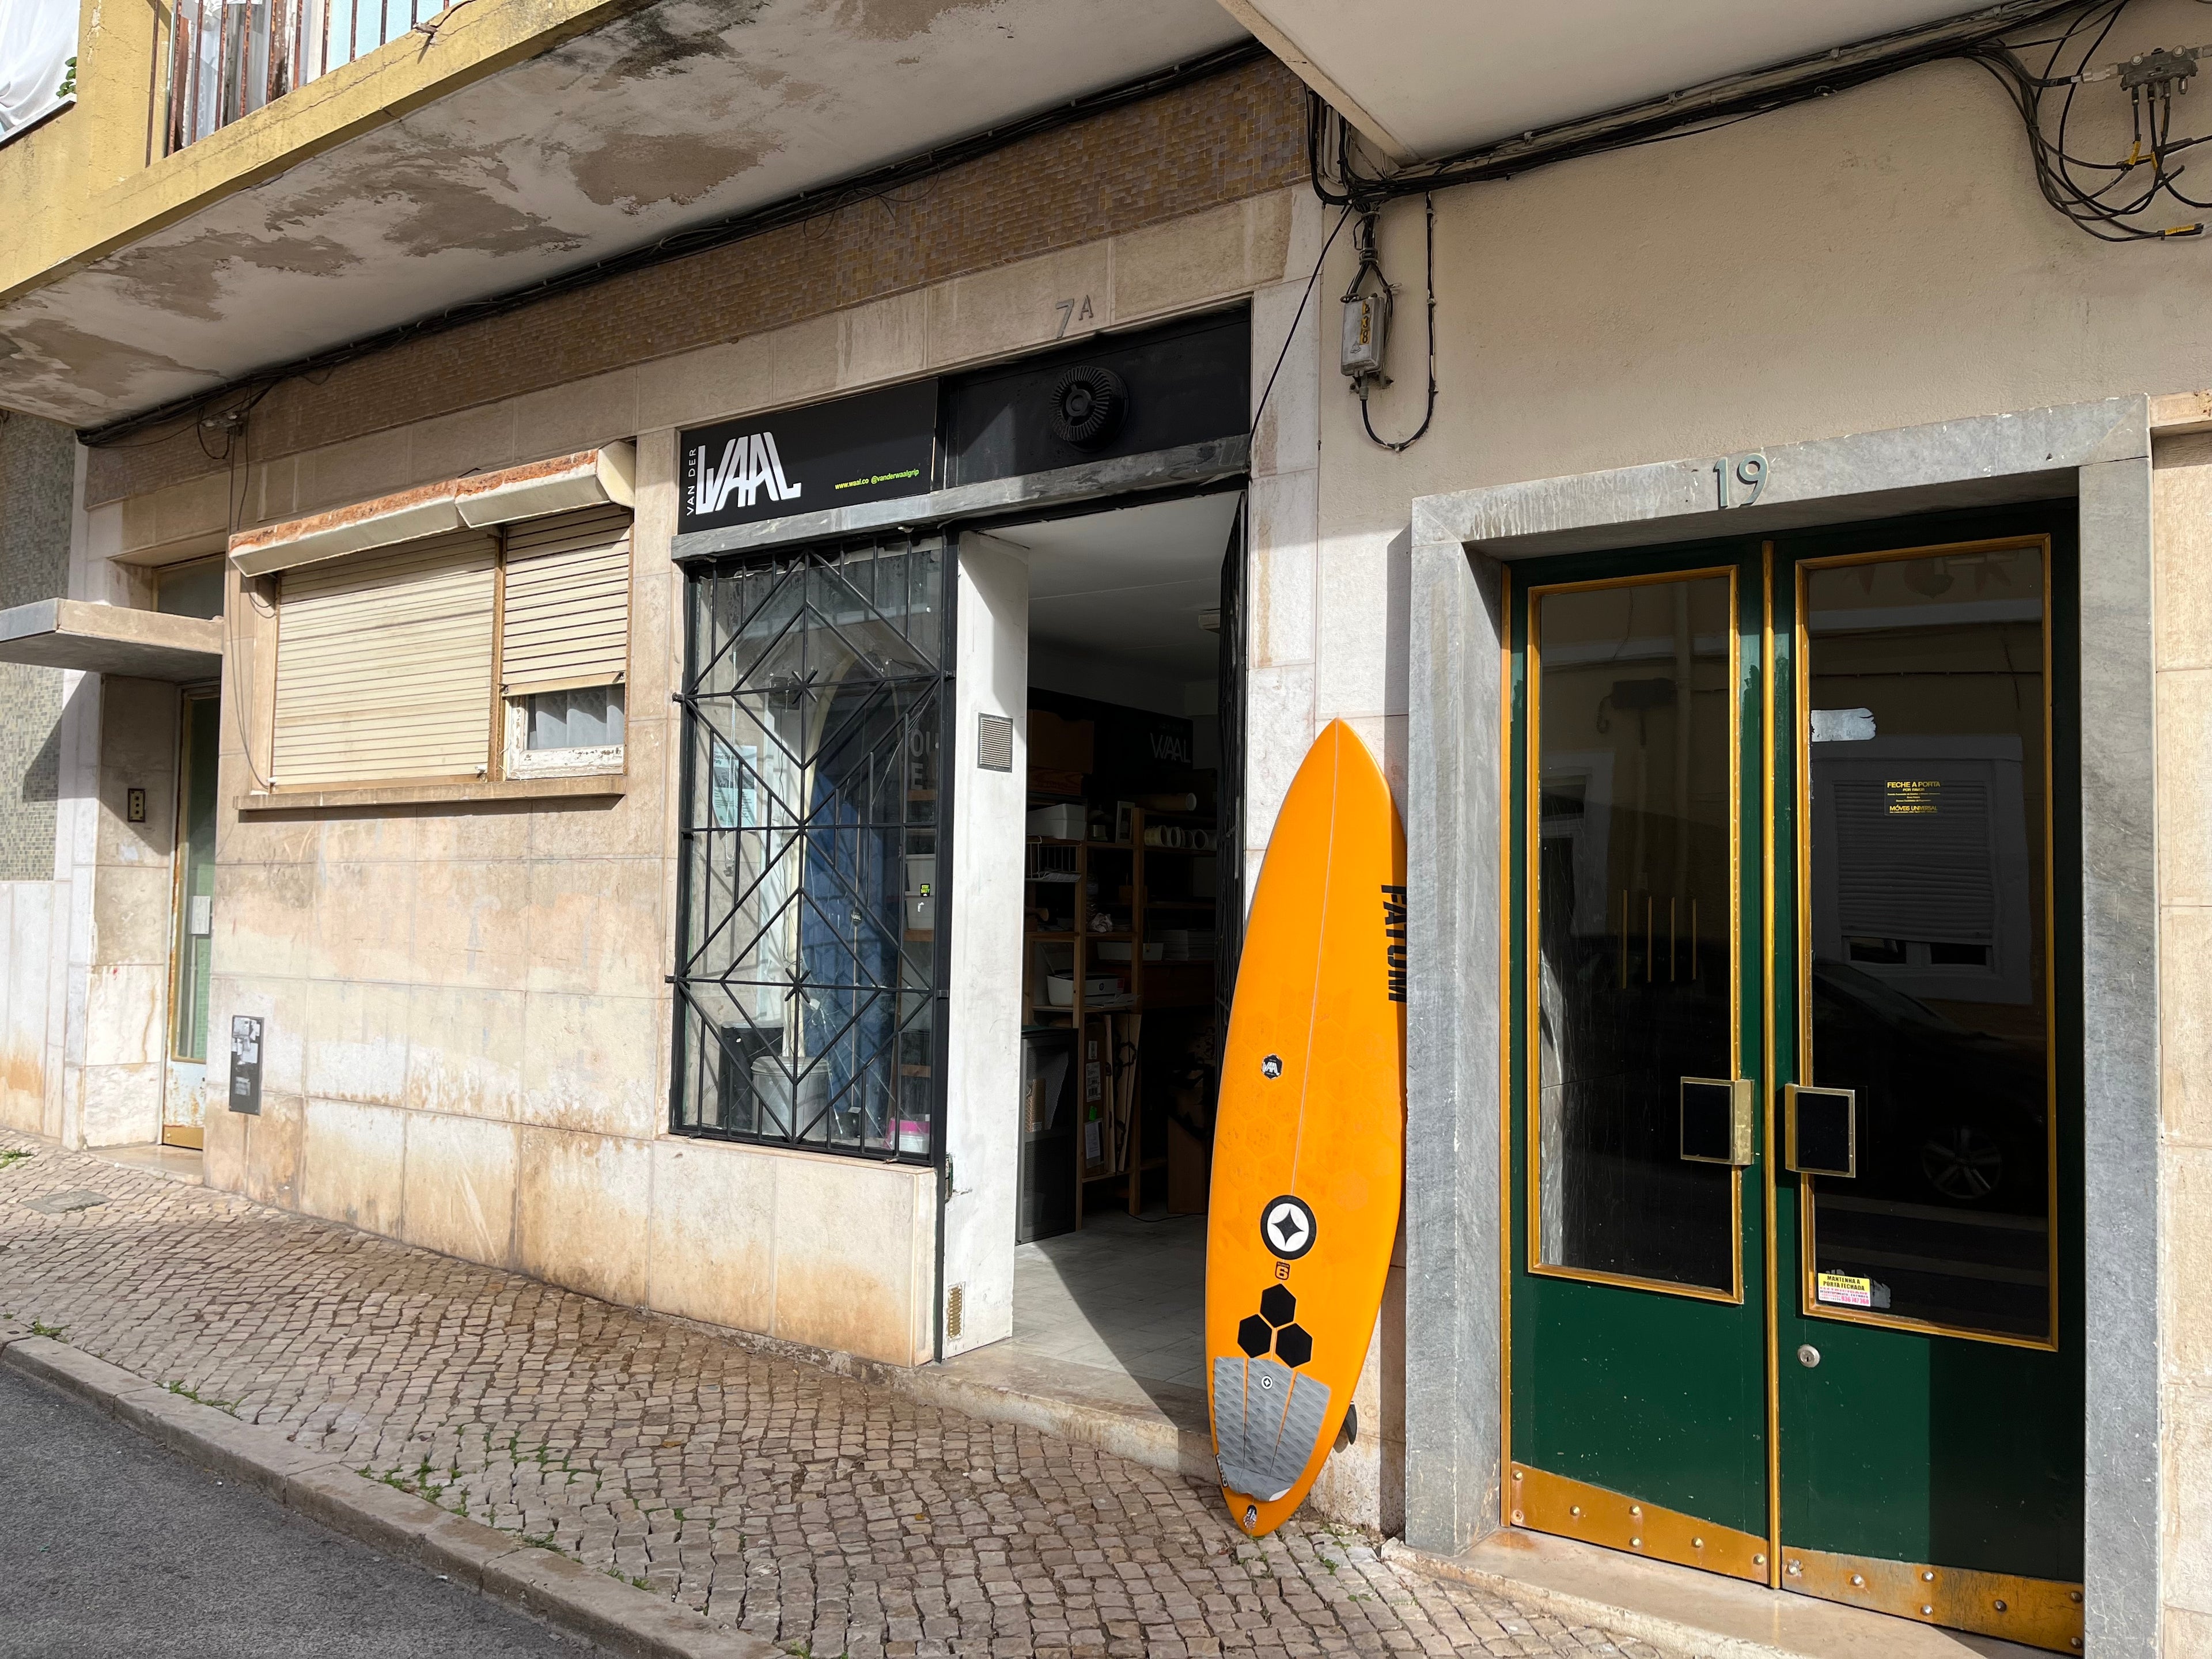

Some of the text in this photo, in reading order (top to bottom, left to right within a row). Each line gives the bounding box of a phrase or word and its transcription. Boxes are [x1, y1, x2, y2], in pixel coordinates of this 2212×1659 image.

[686, 448, 696, 516] VAN DER
[695, 431, 802, 516] WAAL
[835, 468, 919, 490] www.waal.co @vanderwaalgrip
[1713, 453, 1769, 510] 19
[1150, 732, 1191, 763] WAAL
[1827, 1275, 1856, 1283] MANTENHA
[1841, 1283, 1865, 1291] FECHADA
